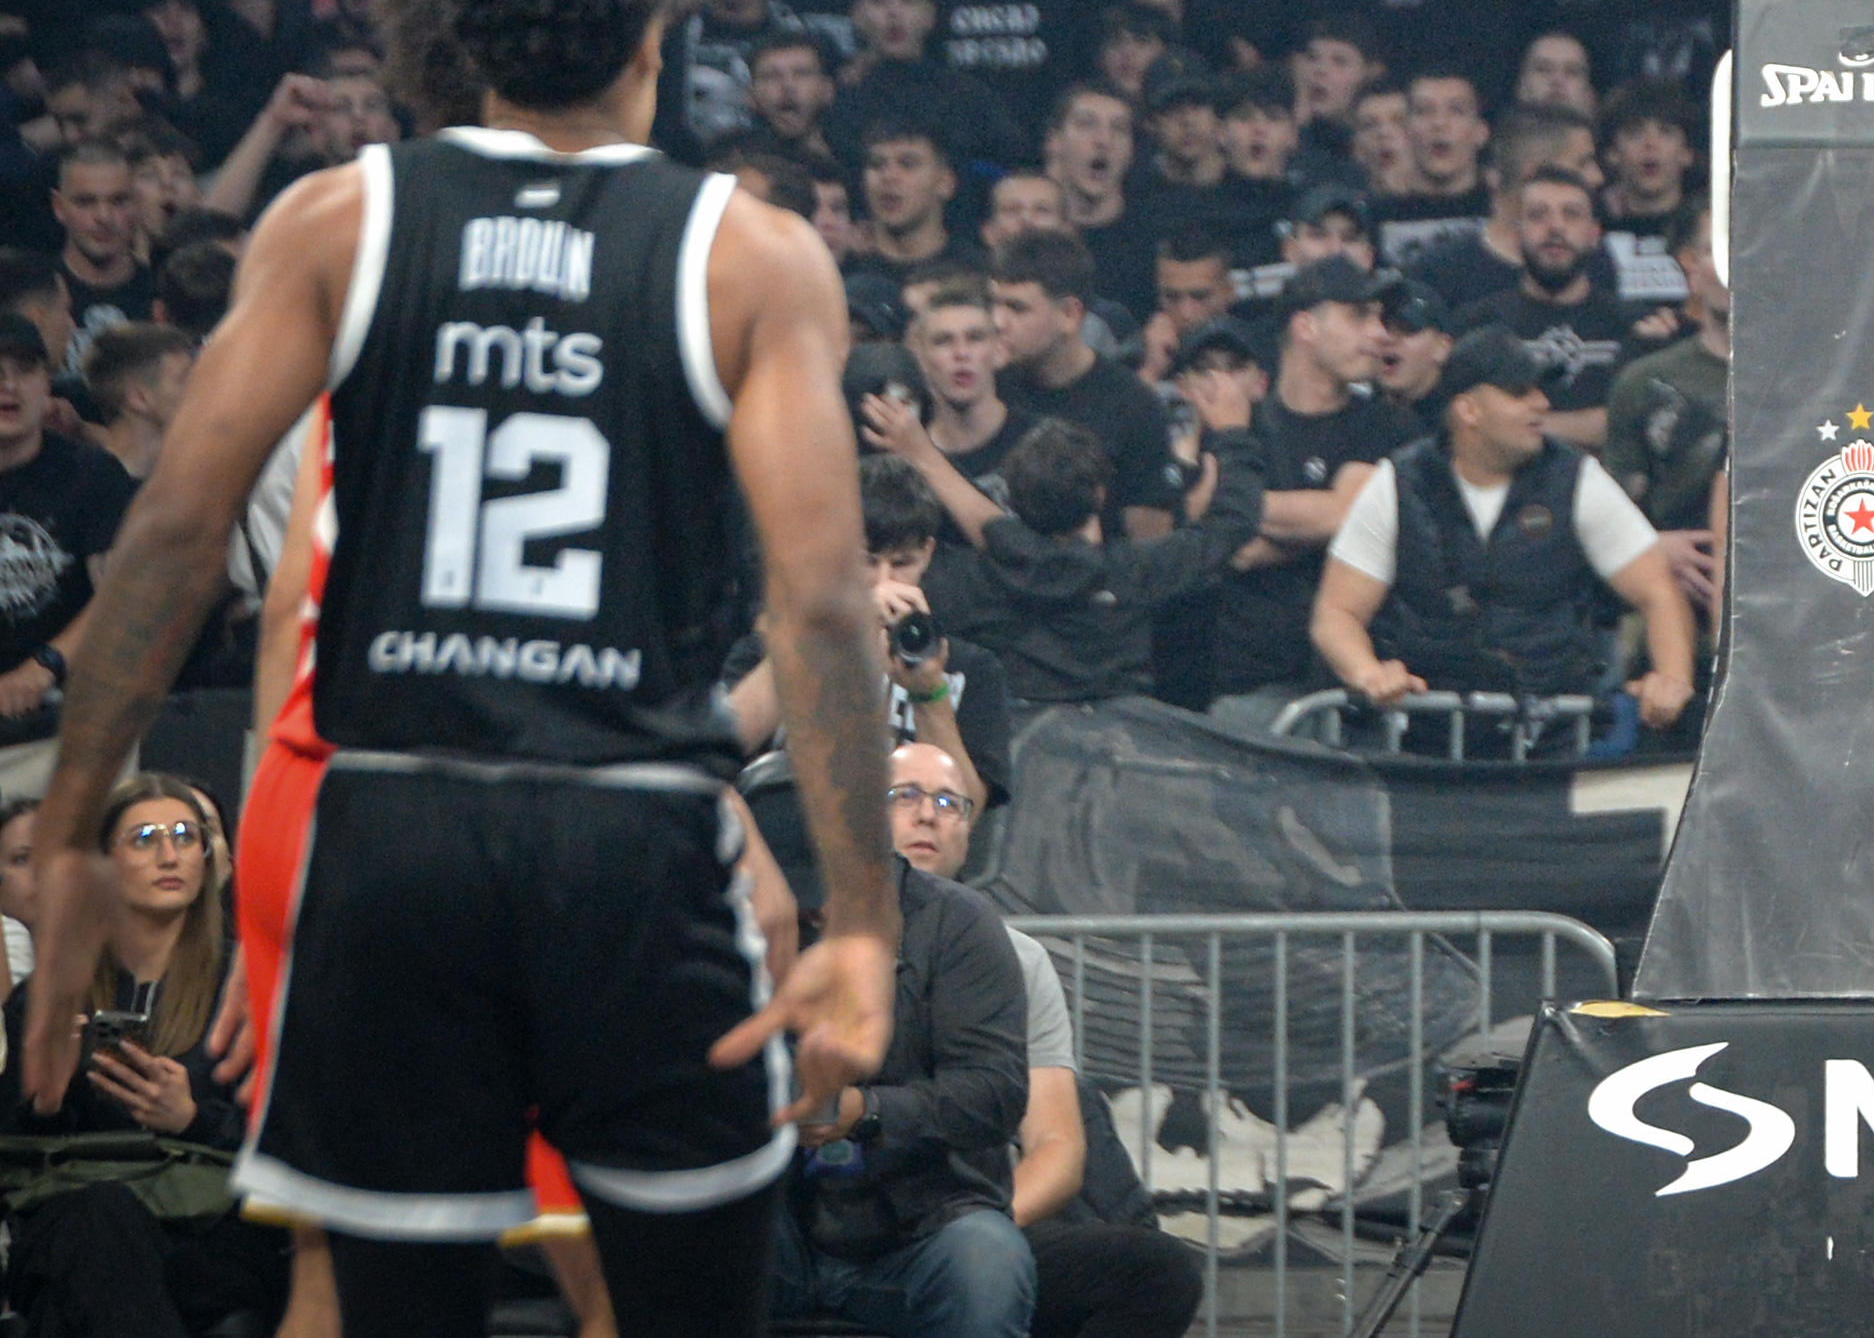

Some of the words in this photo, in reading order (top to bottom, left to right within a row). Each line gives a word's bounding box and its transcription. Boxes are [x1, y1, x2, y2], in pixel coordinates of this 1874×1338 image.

[434, 316, 604, 397] mts
[416, 404, 611, 622] 12
[1803, 468, 1844, 573] PARTIZAN
[368, 630, 643, 692] CHANGAN
